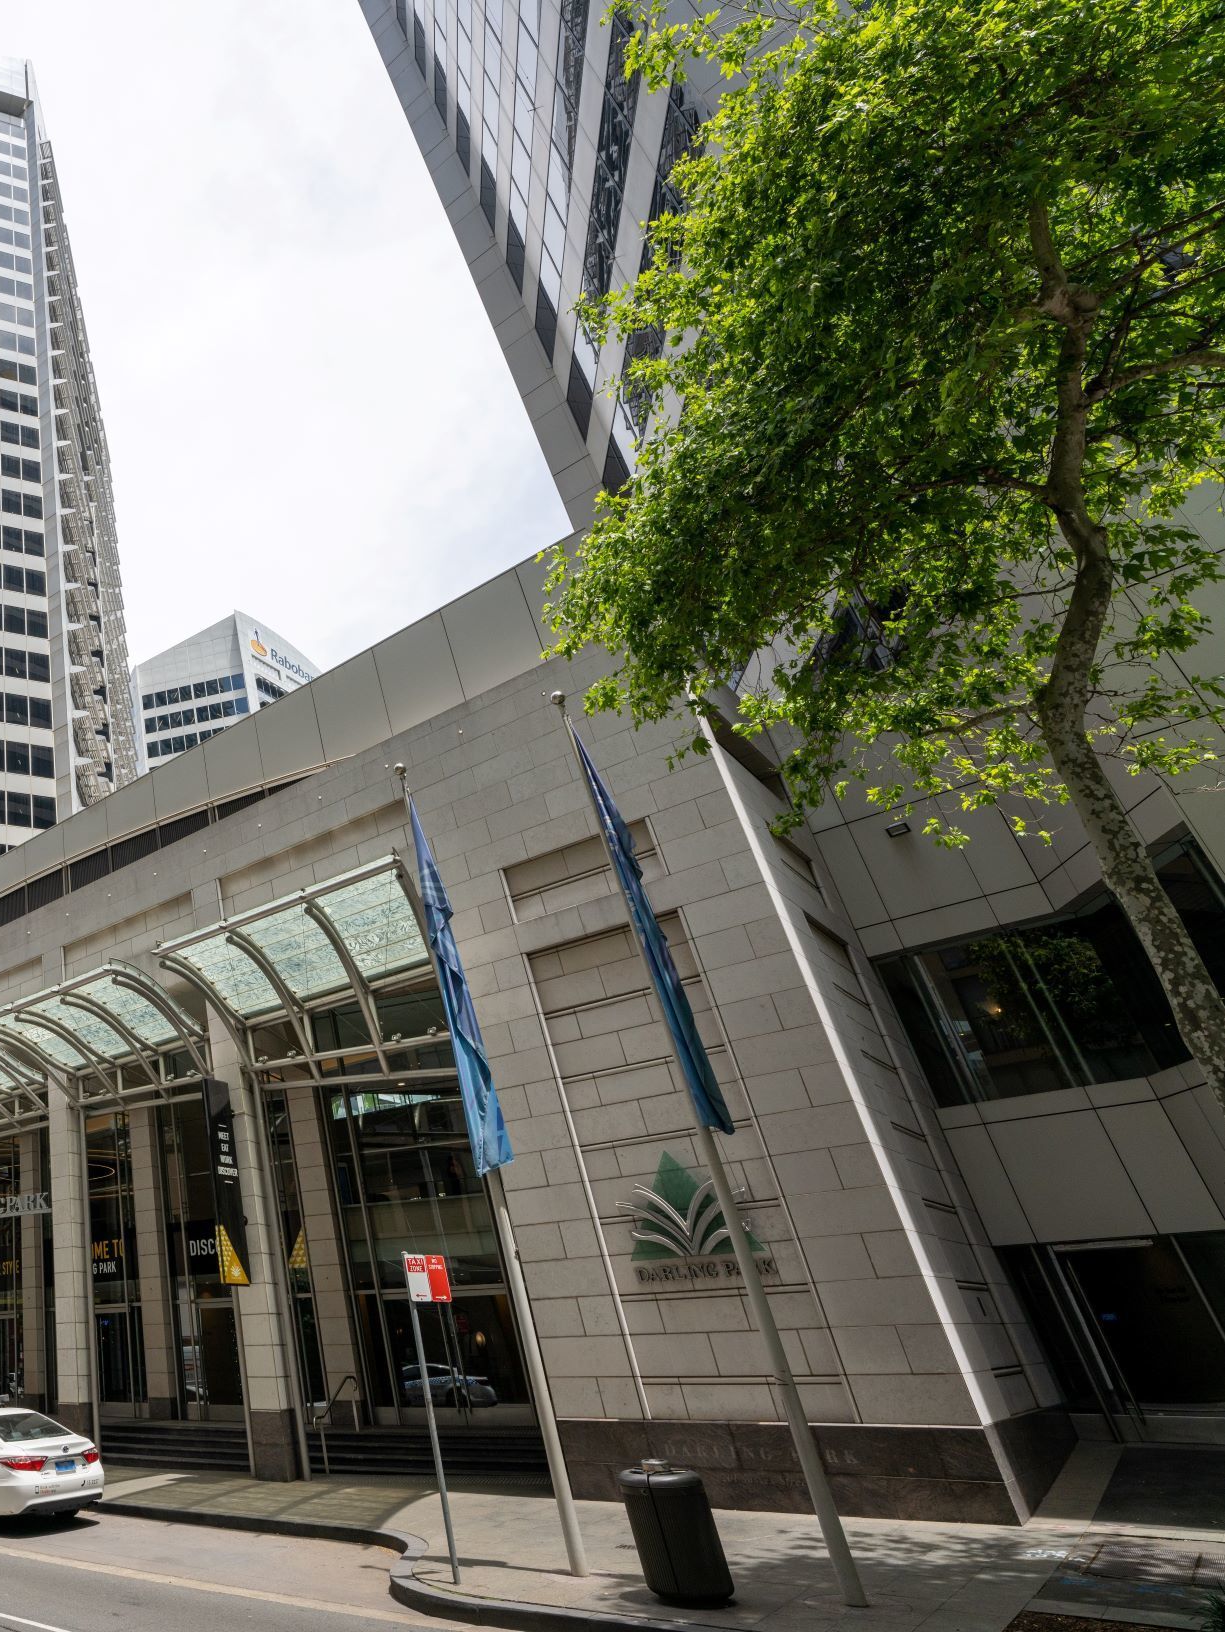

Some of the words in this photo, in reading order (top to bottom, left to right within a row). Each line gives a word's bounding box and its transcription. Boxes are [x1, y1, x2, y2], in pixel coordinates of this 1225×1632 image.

[5, 1192, 49, 1215] PARK
[2, 1259, 20, 1275] STYE
[99, 1261, 117, 1274] PARK
[637, 1263, 718, 1283] DARLING
[723, 1259, 776, 1278] PK
